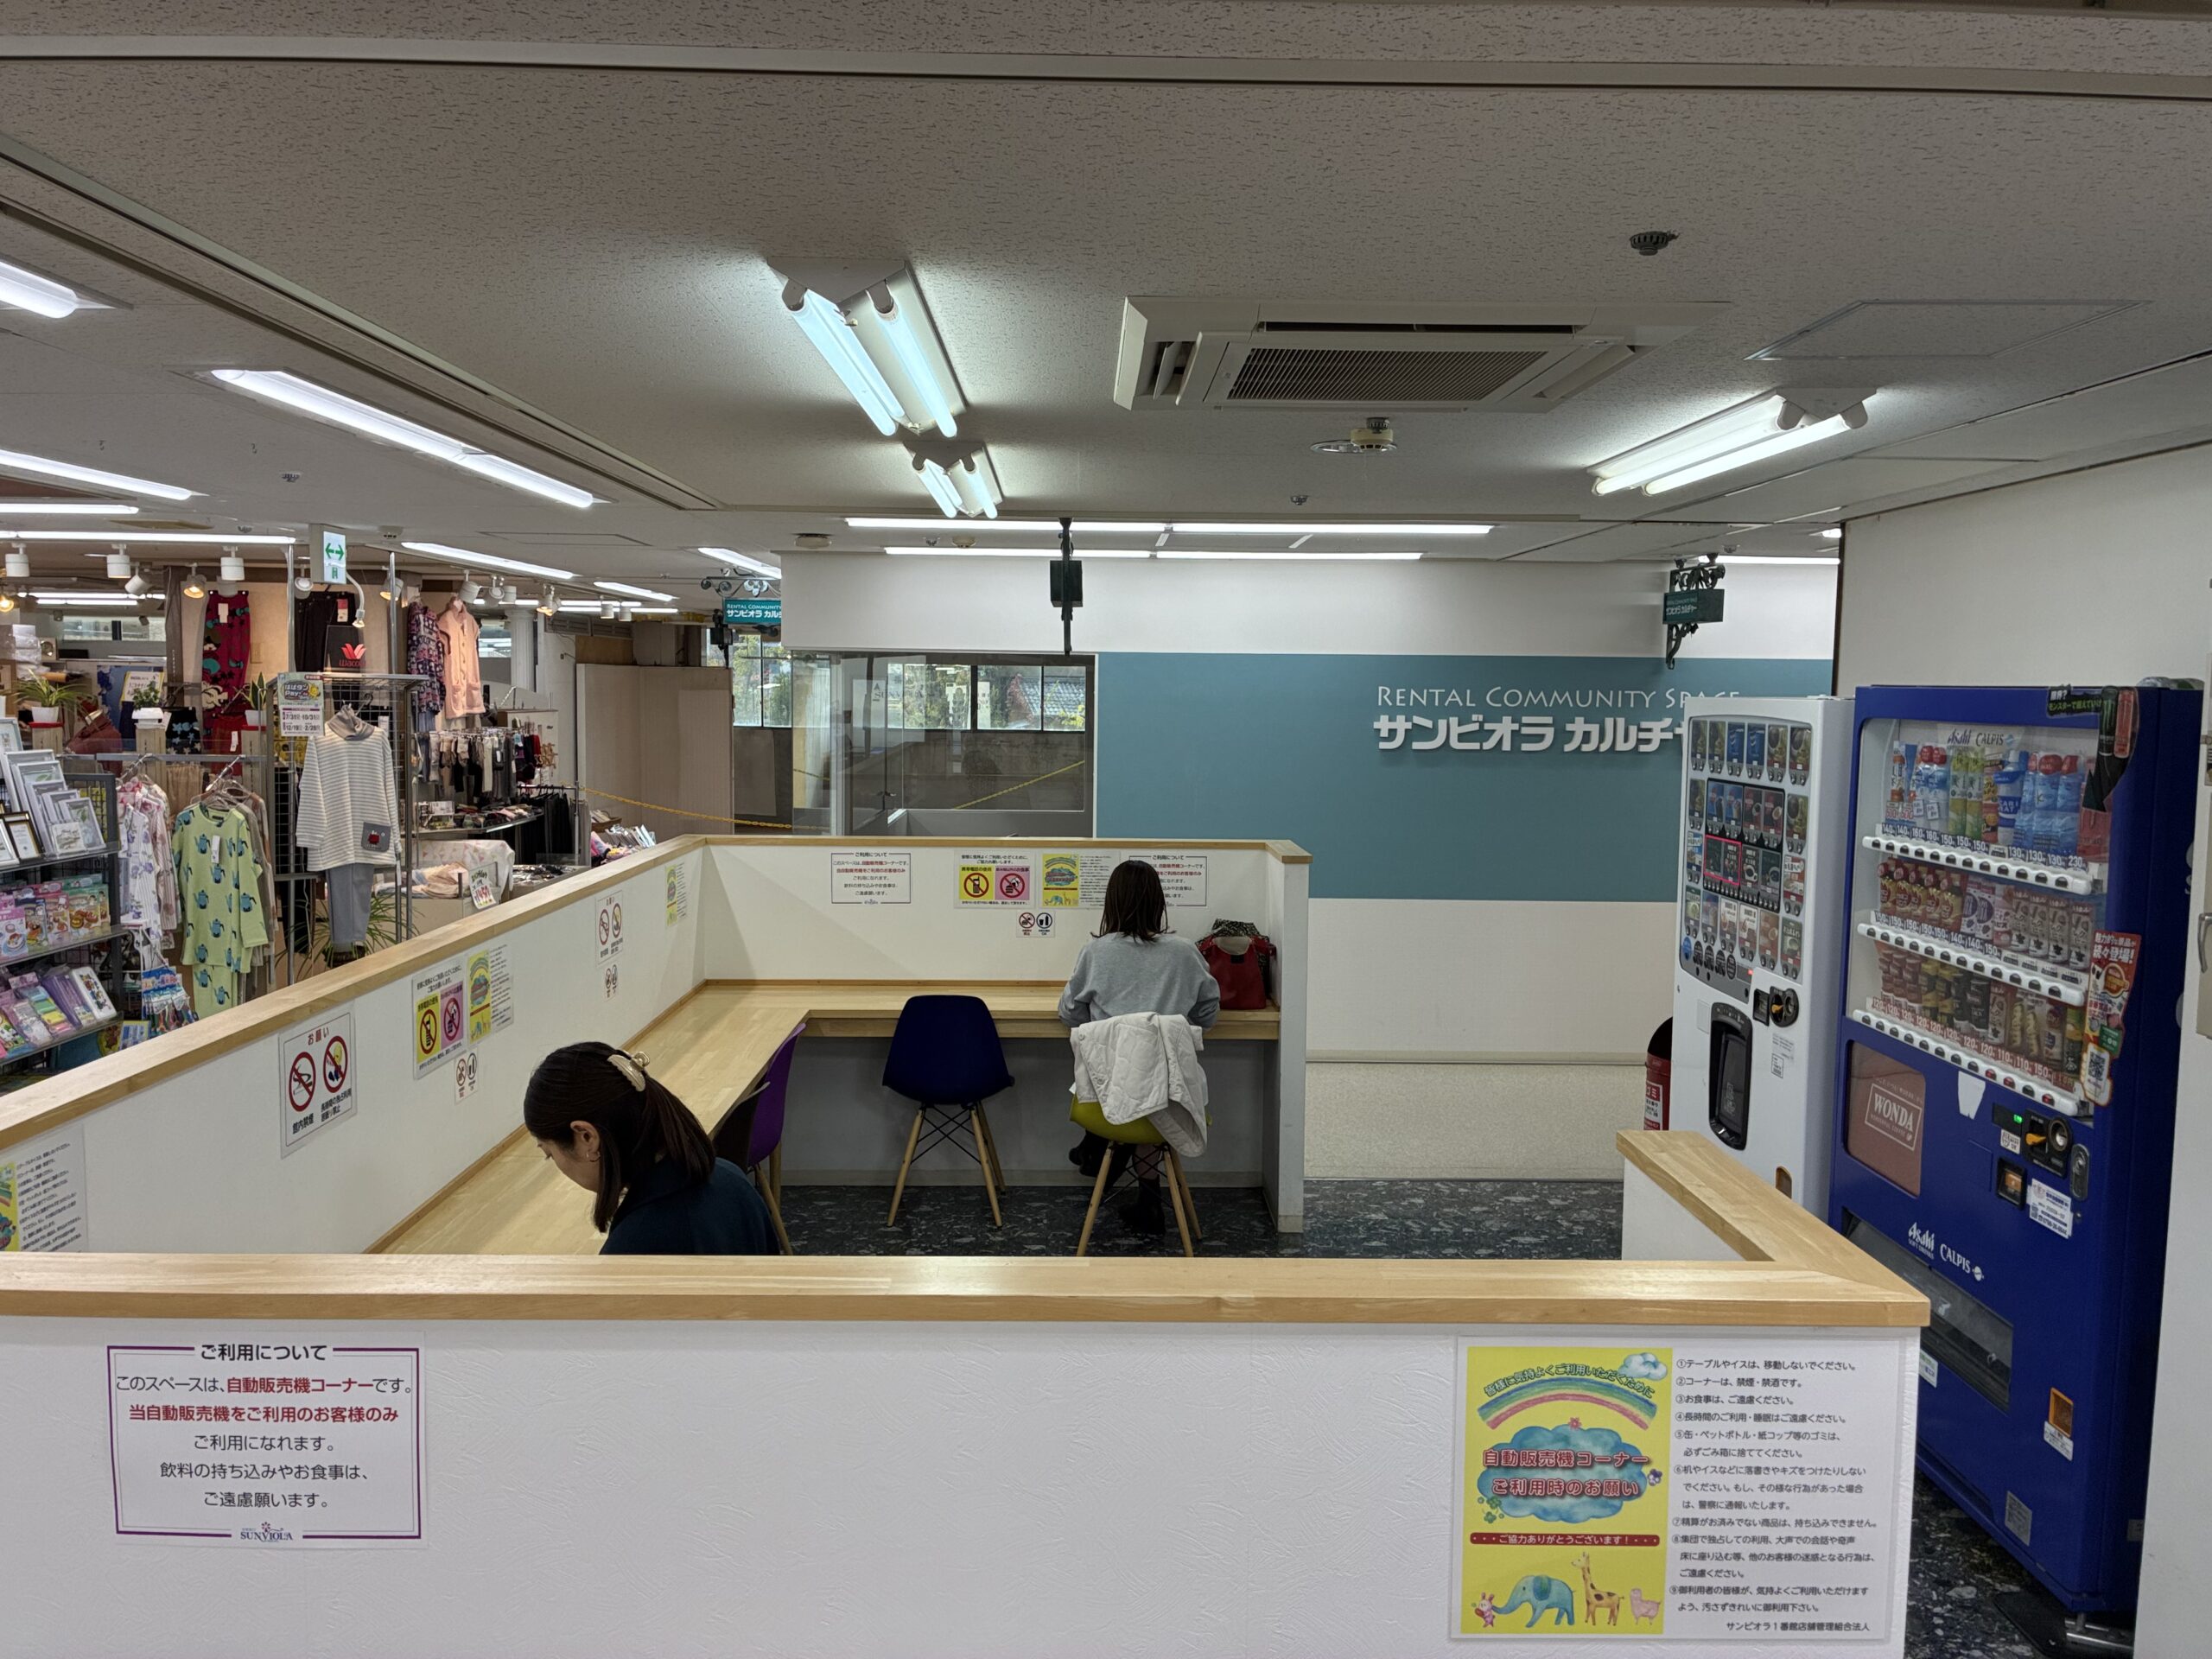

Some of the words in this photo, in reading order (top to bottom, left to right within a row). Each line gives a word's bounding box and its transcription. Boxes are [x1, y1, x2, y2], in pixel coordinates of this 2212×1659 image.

[1374, 715, 1554, 752] サンビオラ
[1564, 716, 1686, 753] カルチ
[1948, 728, 1971, 744] Asahi
[1976, 732, 2005, 747] CALPIS
[308, 1027, 329, 1046] お願い
[1874, 1092, 1914, 1133] WONDA
[292, 1112, 315, 1135] 館内禁煙
[1908, 1221, 1935, 1252] Asahi
[1940, 1243, 1971, 1274] CALPIS
[200, 1343, 327, 1361] ご利用について
[1676, 1359, 1856, 1370] ①テーブルやイスは、移動しないでください。
[116, 1375, 412, 1394] このスペースは、自動販売機コーナーです。
[1676, 1376, 1802, 1388] ②コーナーは、禁煙・禁酒です。
[1676, 1395, 1794, 1406] ③お食事は、ご遠慮ください。
[129, 1404, 399, 1423] 当自動販売機をご利用のお客様のみ
[1675, 1412, 1847, 1424] ④長時間のご利用・睡眠はご遠慮ください。
[194, 1433, 334, 1452] ご利用になれます。
[1483, 1449, 1650, 1467] 自動販売機コーナー
[1683, 1448, 1803, 1459] 必ずごみ箱に捨ててください。
[160, 1462, 370, 1480] 飲料の持ち込みやお食事は、
[1674, 1465, 1866, 1476] ⑥机やイスなどに落書きやキズをつけたりしない
[1491, 1478, 1640, 1497] ご利用時のお願い
[203, 1491, 329, 1509] ご遠慮願います。
[1682, 1501, 1790, 1510] は、警察に通報いたします。
[240, 1531, 293, 1541] SUNVIOLA
[1679, 1569, 1745, 1579] ご遠慮ください。
[1678, 1603, 1820, 1612] よう、汚さずきれいに御利用下さい。
